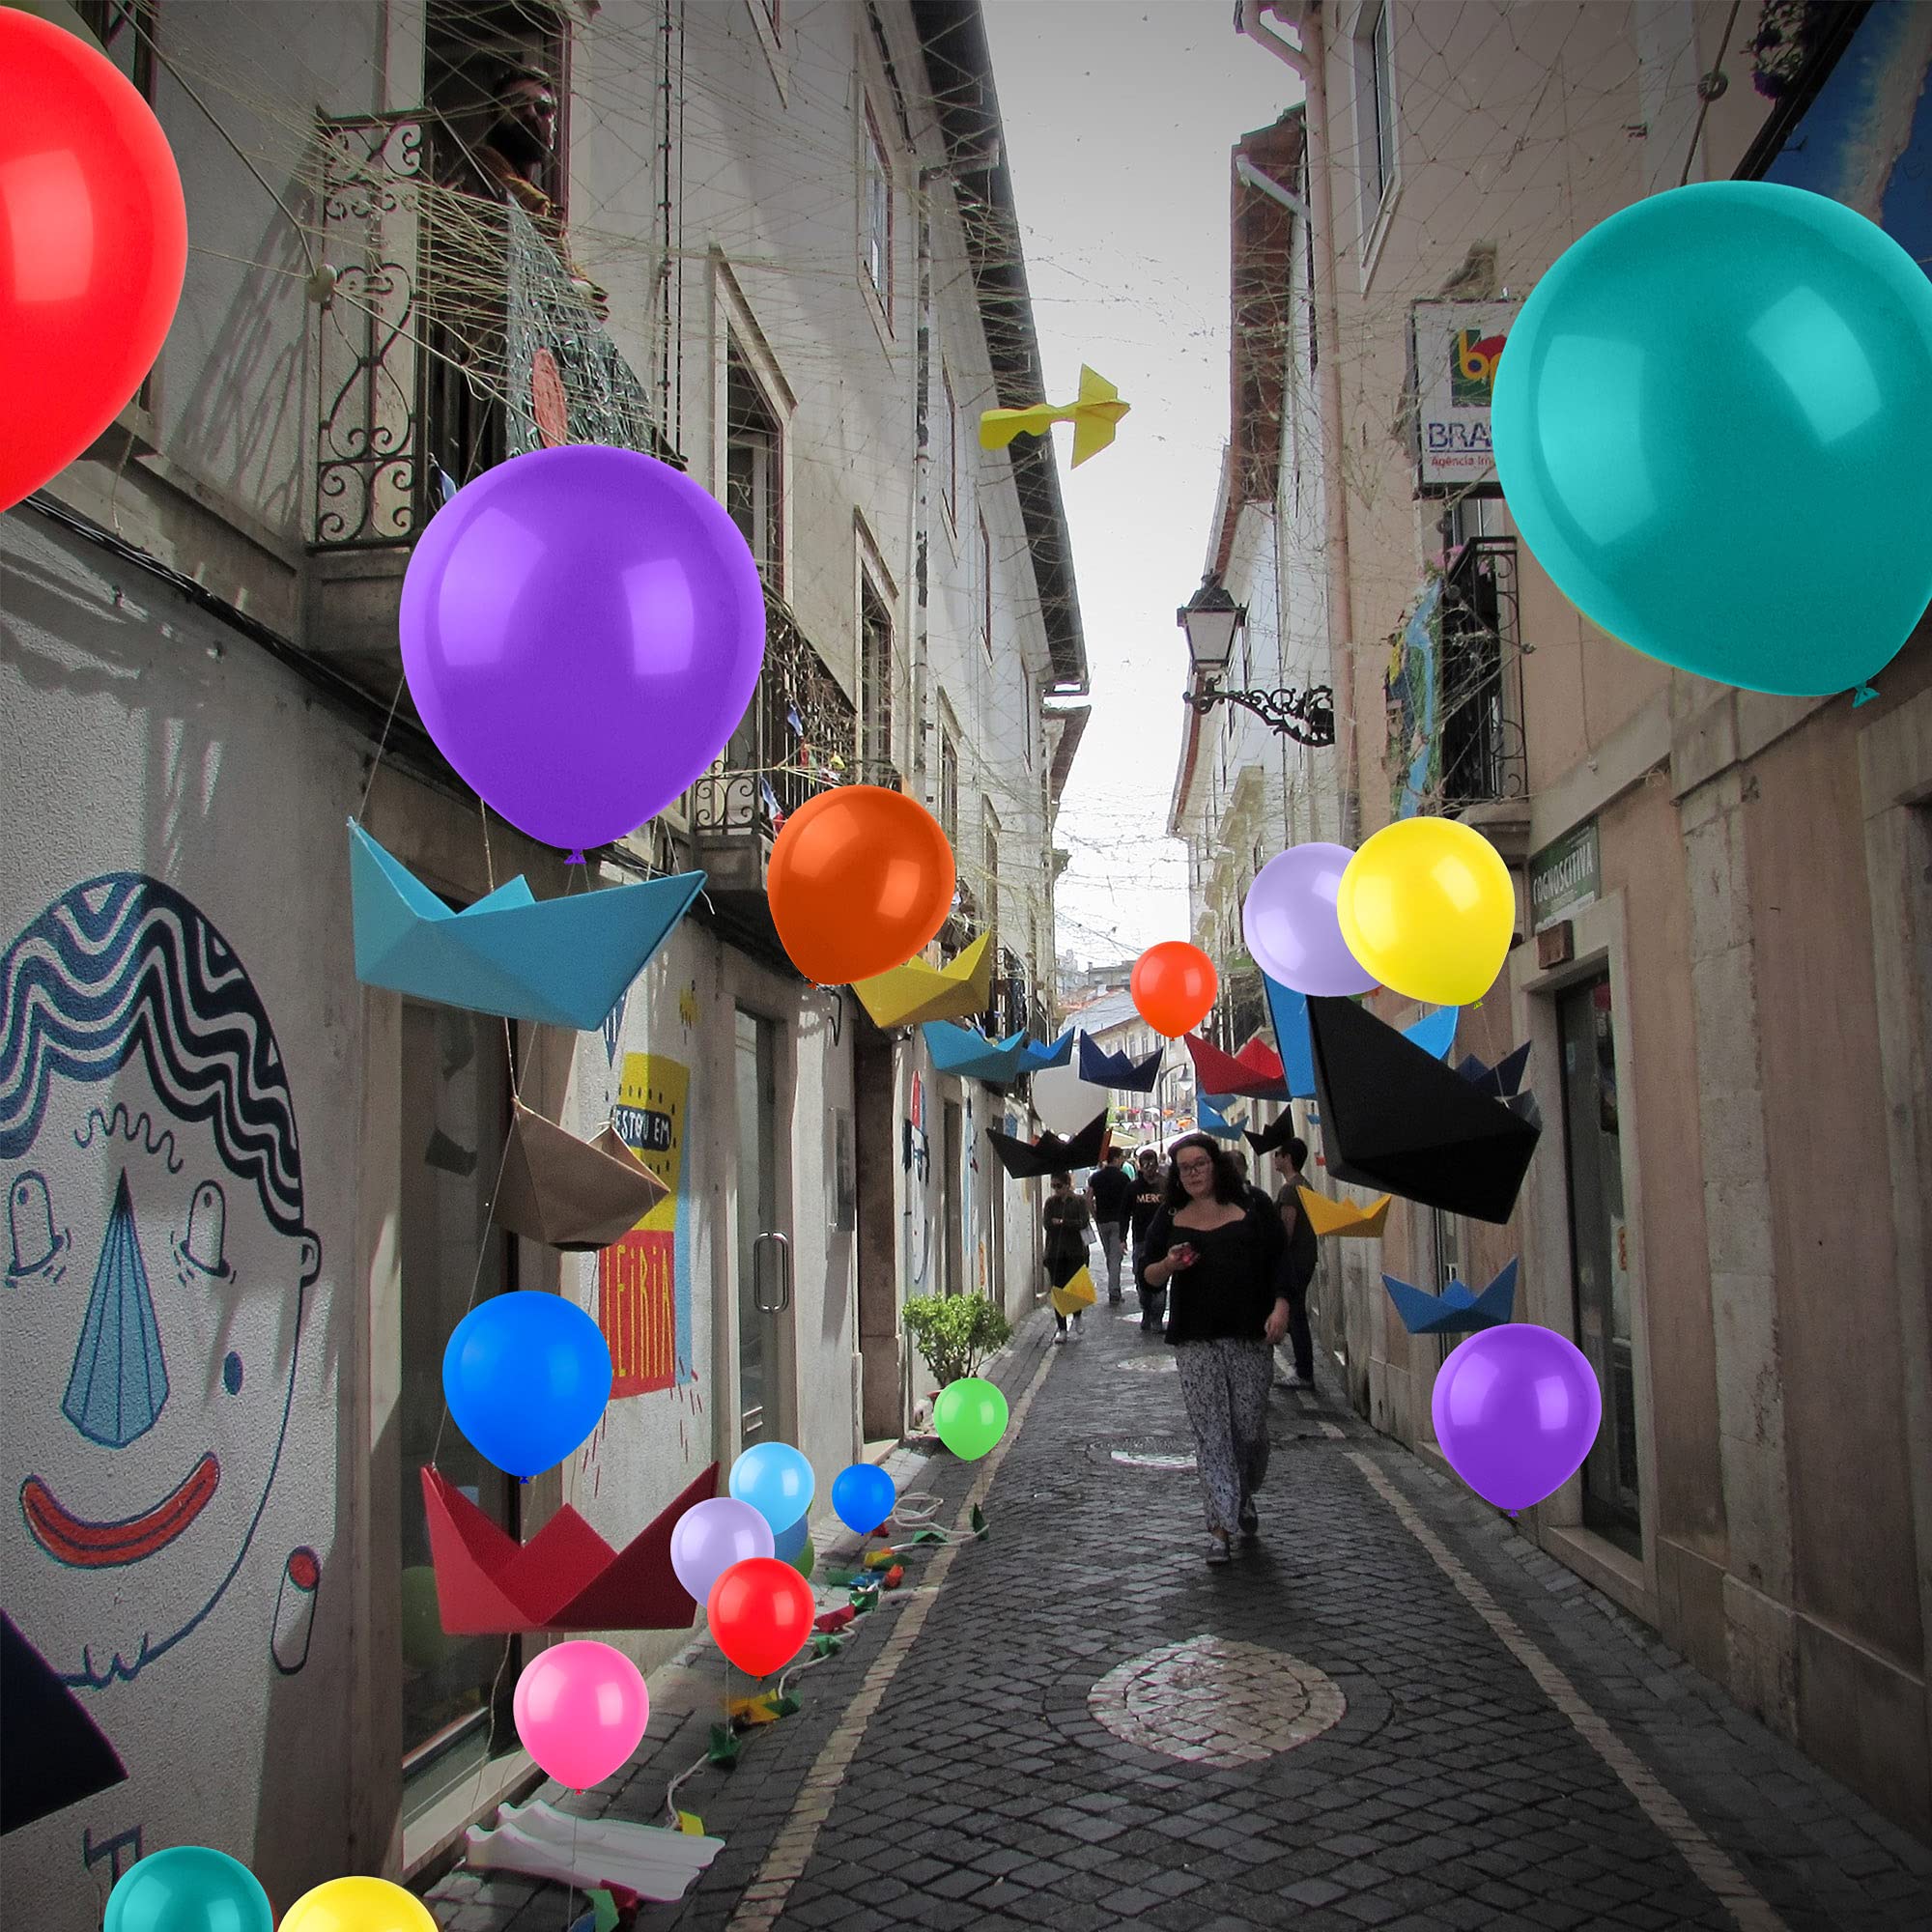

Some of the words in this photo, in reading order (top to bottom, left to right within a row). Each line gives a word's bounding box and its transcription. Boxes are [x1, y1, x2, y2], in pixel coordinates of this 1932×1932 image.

[1429, 422, 1492, 447] BRA
[615, 1109, 649, 1140] ESTOU
[654, 1117, 669, 1146] EM
